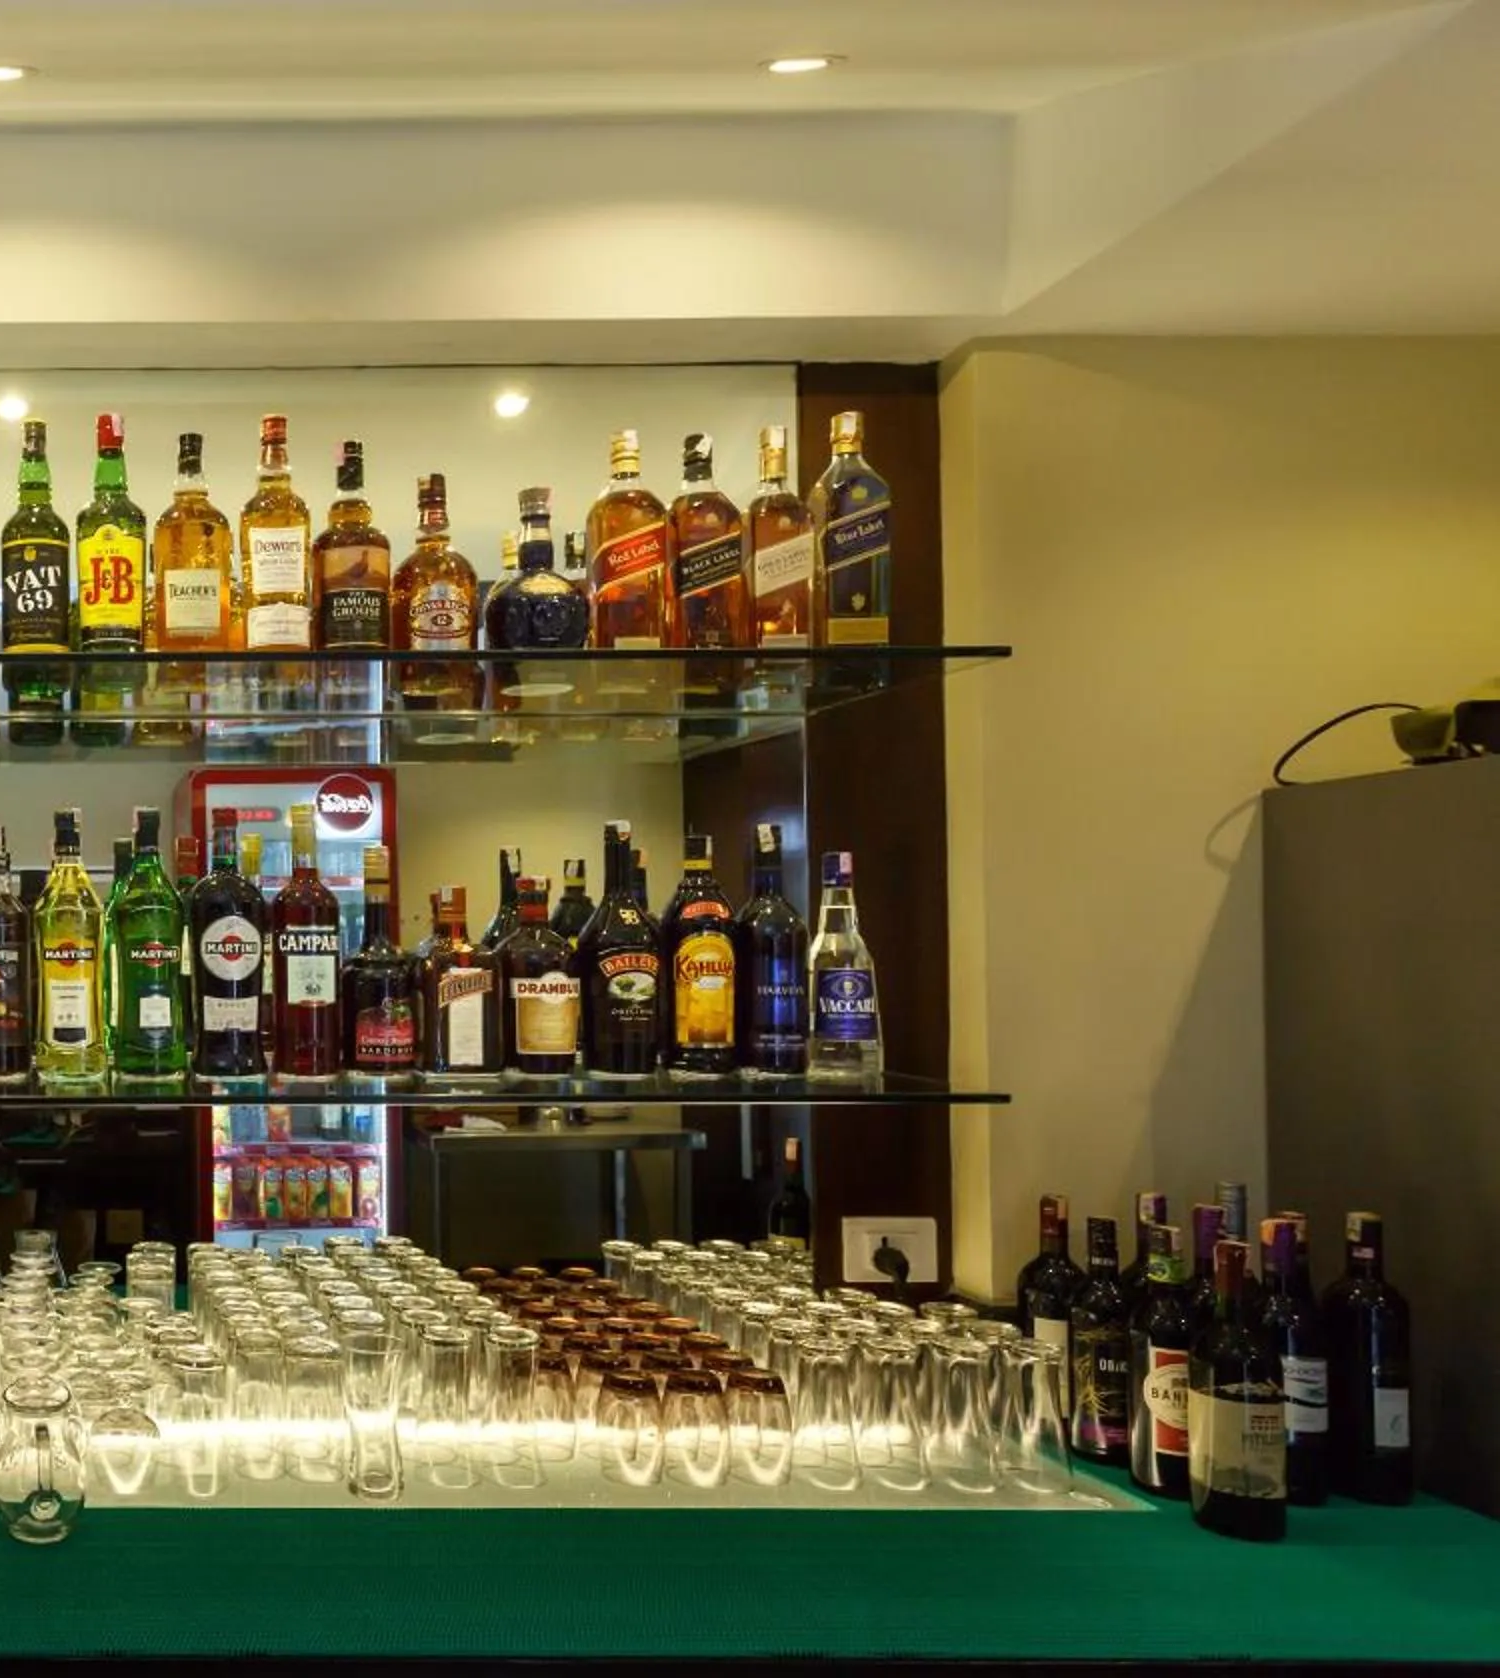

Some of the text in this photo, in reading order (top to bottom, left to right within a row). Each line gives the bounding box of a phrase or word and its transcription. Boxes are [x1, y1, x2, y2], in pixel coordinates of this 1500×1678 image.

[4, 565, 62, 594] VAT
[169, 583, 218, 598] TEACHER'S
[17, 589, 53, 613] 69
[333, 596, 381, 607] FAMOUS
[332, 606, 381, 617] GROUSE
[45, 949, 92, 959] MARTINI
[131, 949, 178, 959] MARTINI
[206, 943, 256, 954] MARTINI
[819, 997, 875, 1013] VACCARI
